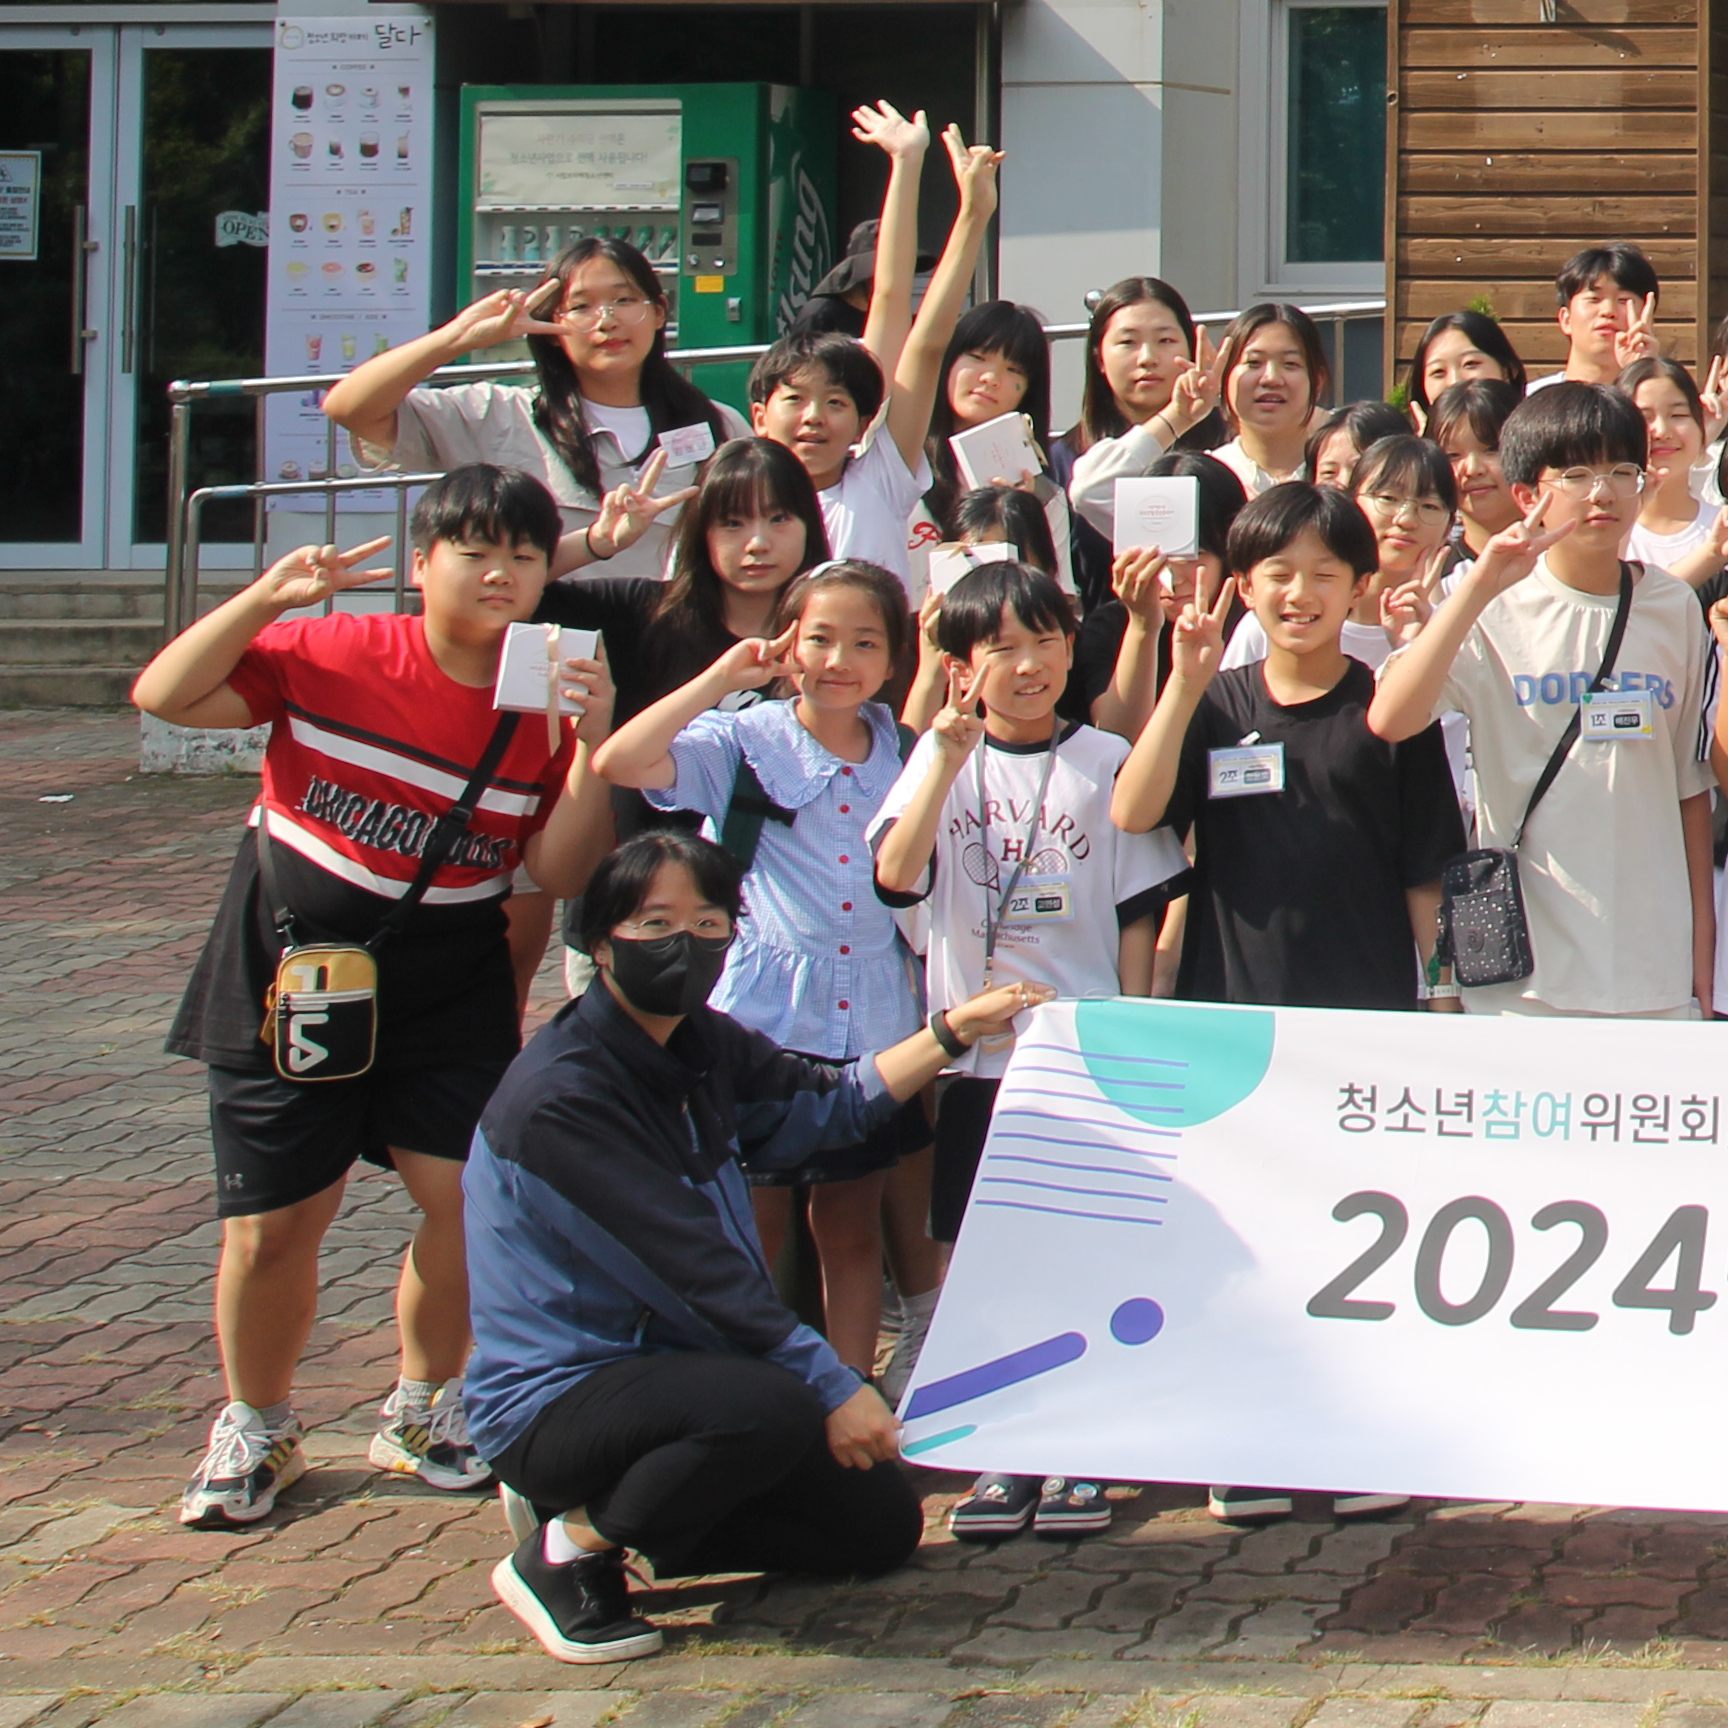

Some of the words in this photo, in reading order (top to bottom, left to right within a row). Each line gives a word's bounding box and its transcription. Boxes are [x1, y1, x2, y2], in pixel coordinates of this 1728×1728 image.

[374, 22, 423, 50] 달다
[949, 798, 1091, 862] HARVARD
[1001, 838, 1025, 863] H
[1010, 897, 1030, 913] 2조
[289, 964, 330, 1073] FILA
